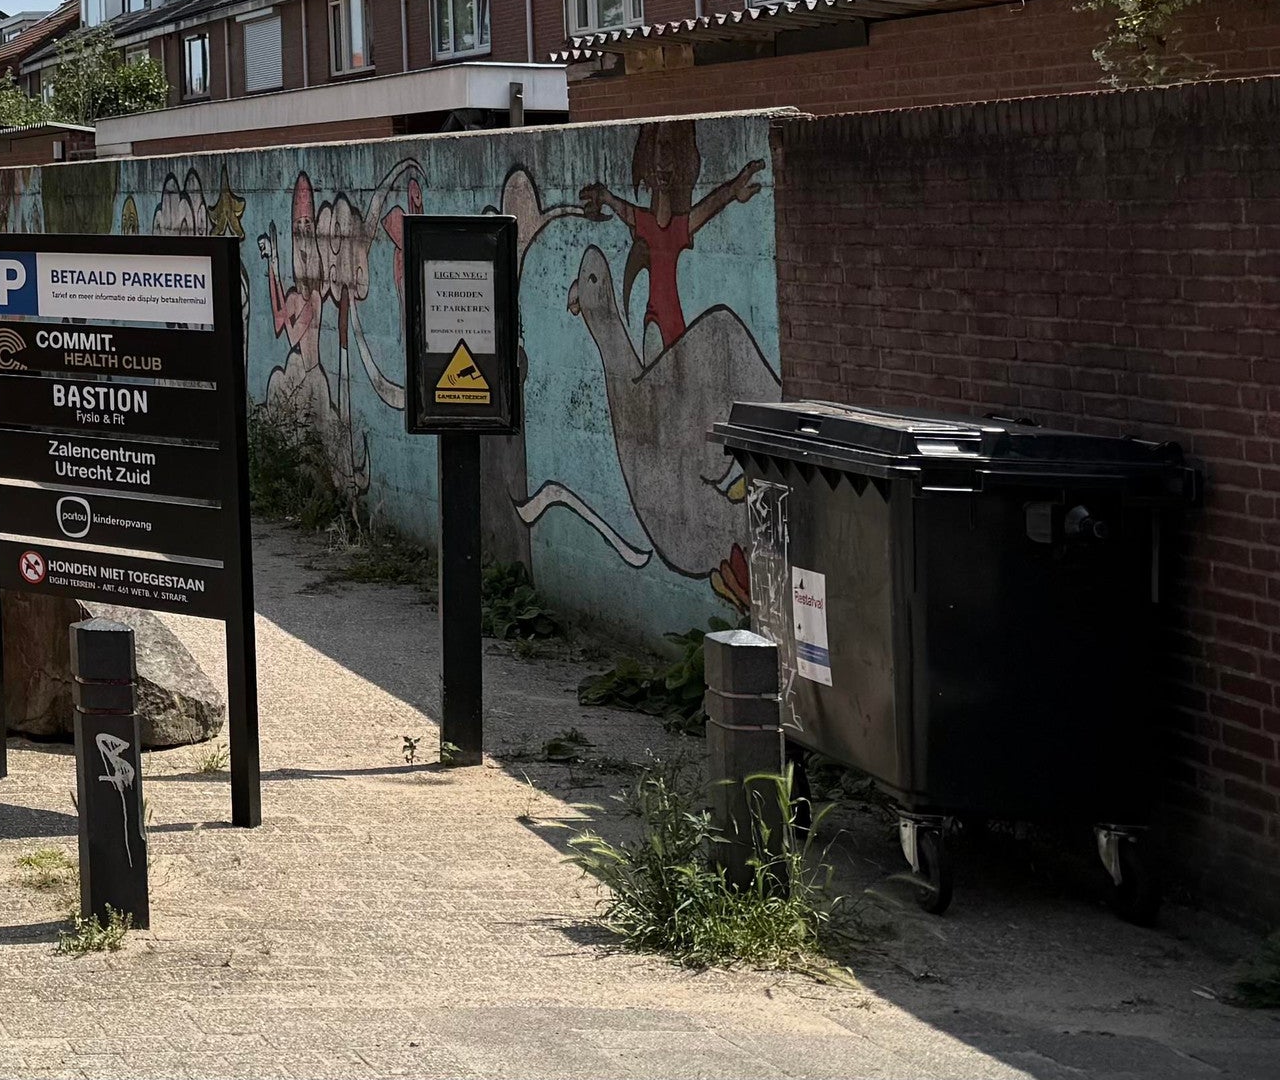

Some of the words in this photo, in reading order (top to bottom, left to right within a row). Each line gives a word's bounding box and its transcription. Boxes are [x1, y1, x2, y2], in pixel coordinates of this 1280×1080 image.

[51, 269, 116, 286] BETAALD
[122, 272, 205, 289] PARKEREN
[52, 291, 67, 299] Tarief
[95, 293, 125, 302] informatie
[137, 295, 159, 304] display
[161, 296, 206, 305] betaalterminal
[36, 331, 115, 351] COMMIT.
[64, 352, 118, 368] HEALTH
[123, 355, 162, 370] CLUB
[53, 384, 147, 413] BASTION
[77, 410, 99, 424] Fysio
[104, 415, 110, 424] &
[113, 413, 125, 425] Fit
[48, 440, 156, 465] Zalencentrum
[55, 461, 113, 481] Utrecht
[116, 467, 150, 485] Zuid
[93, 514, 152, 531] kinderopvang
[48, 560, 97, 577] HONDEN
[100, 567, 125, 581] NIET
[128, 570, 205, 592] TOEGESTAAN
[49, 576, 68, 585] EIGEN
[70, 579, 95, 589] TERREIN
[102, 584, 116, 593] ART.
[131, 588, 151, 598] WETB.
[794, 591, 824, 610] Restafval
